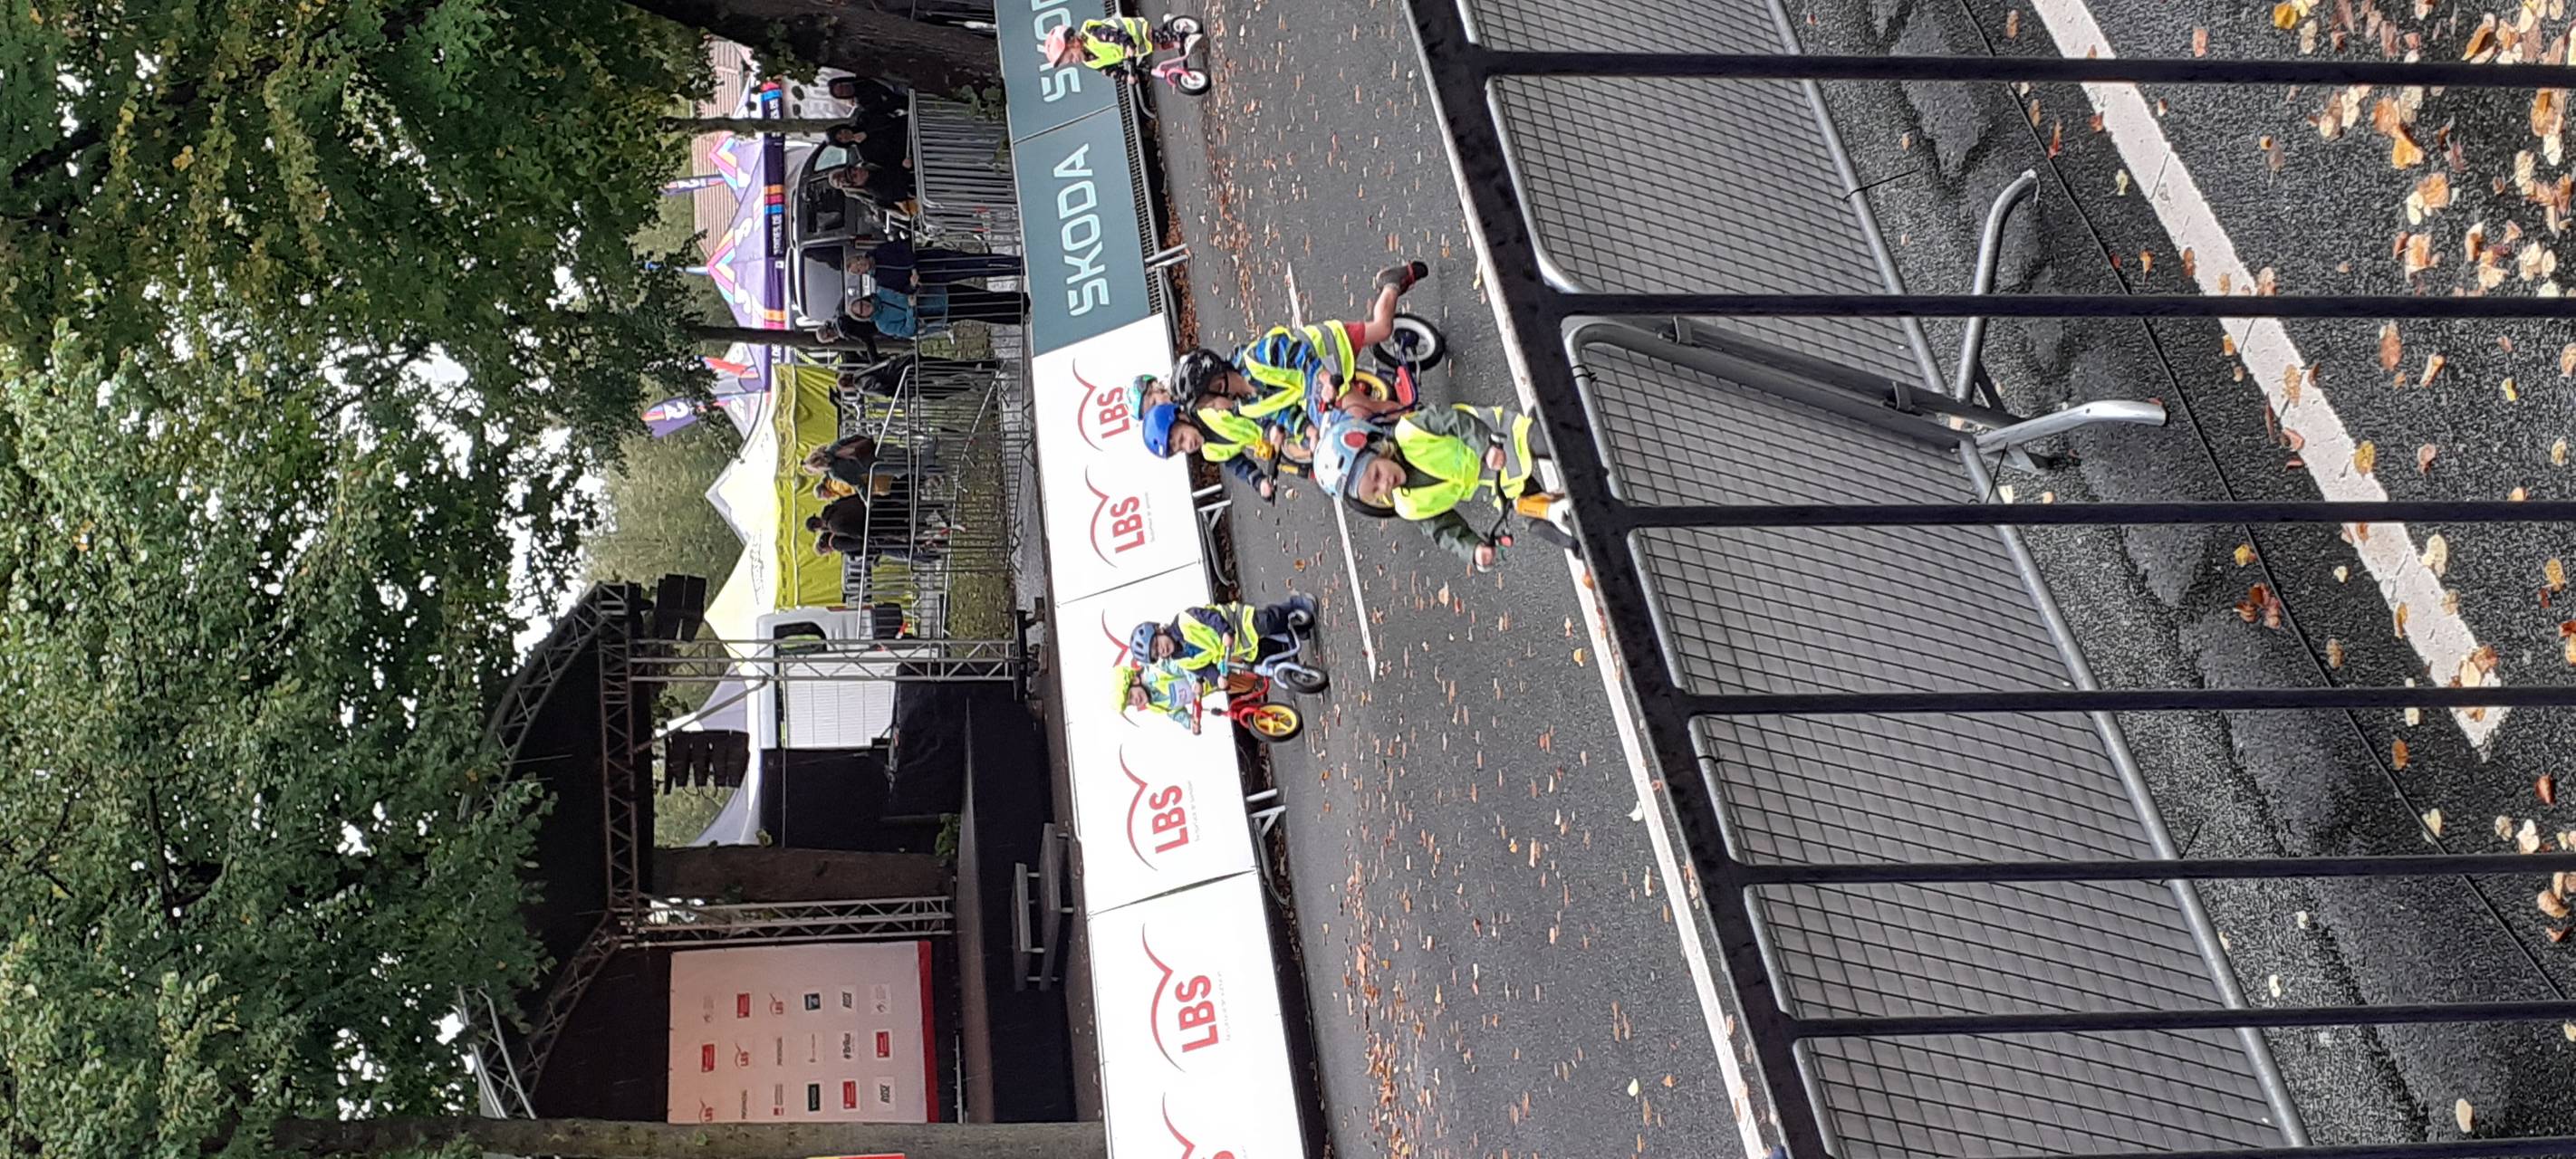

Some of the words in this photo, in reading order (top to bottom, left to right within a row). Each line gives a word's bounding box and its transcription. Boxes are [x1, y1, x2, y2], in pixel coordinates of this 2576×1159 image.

[1098, 388, 1130, 437] LBS
[1110, 496, 1145, 552] LBS
[1149, 786, 1189, 854] LBS
[1175, 975, 1218, 1052] LBS
